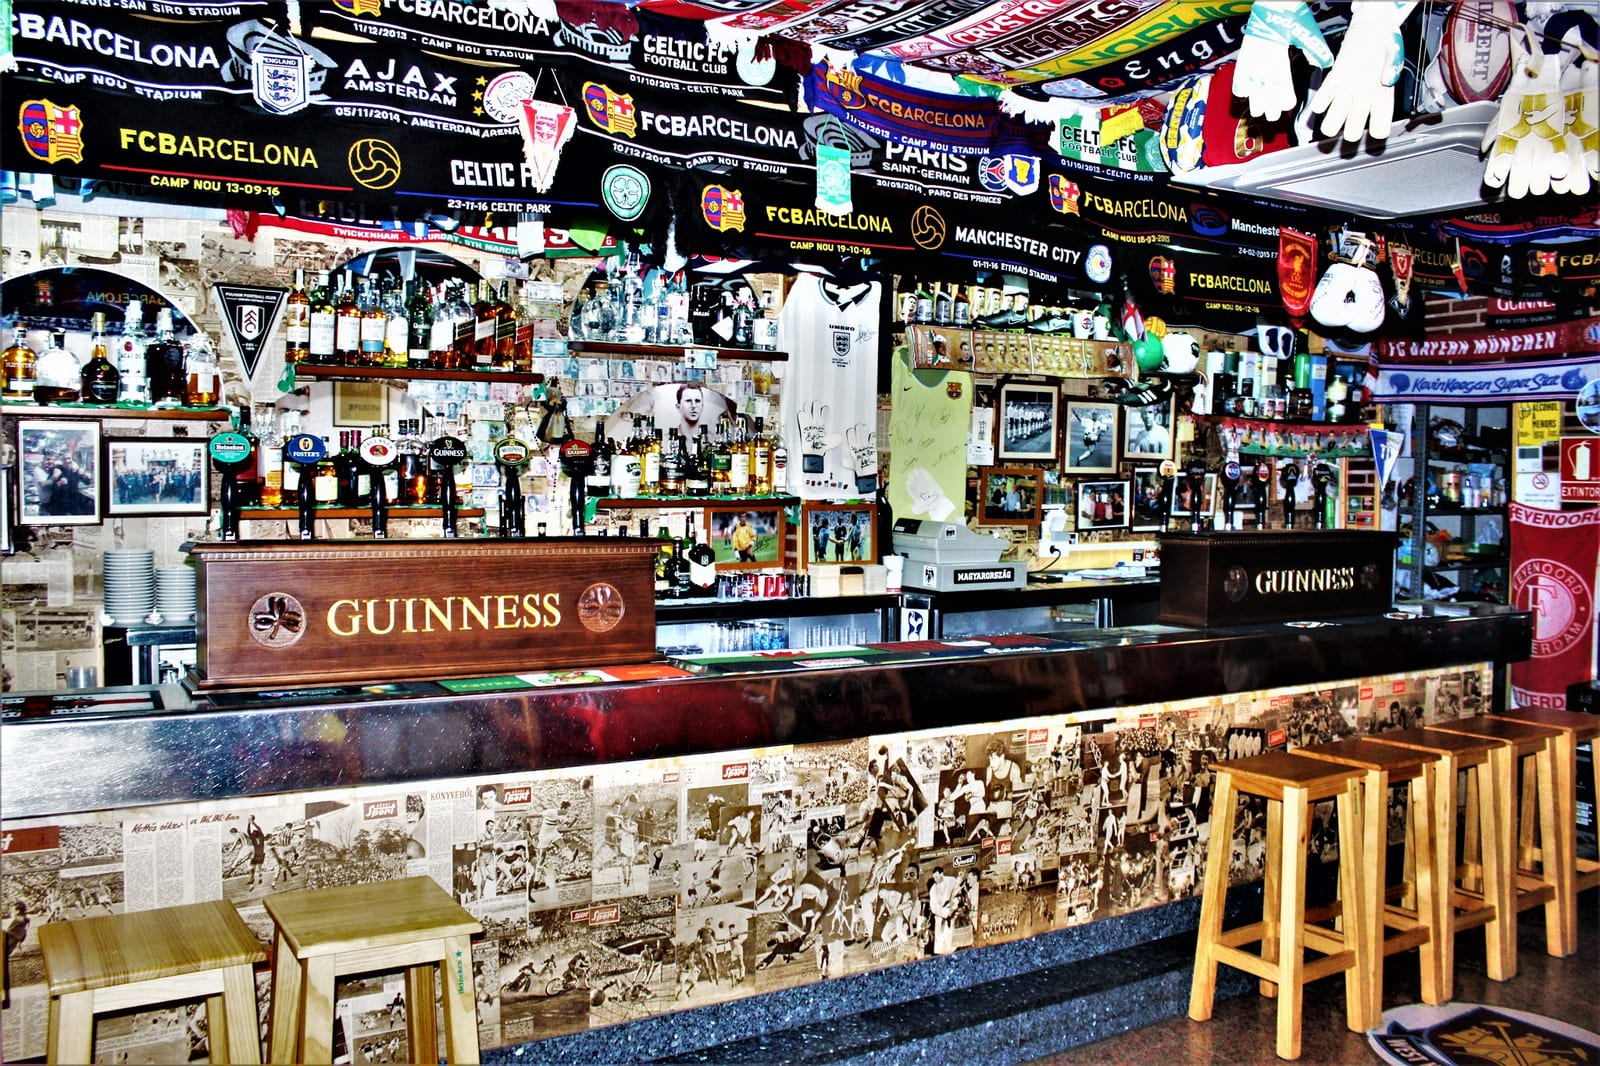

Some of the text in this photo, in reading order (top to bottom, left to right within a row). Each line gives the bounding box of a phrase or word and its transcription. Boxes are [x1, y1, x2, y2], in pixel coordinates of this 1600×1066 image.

[121, 0, 147, 11] SAN
[152, 3, 183, 16] SIRO
[189, 7, 241, 16] STADIUM
[352, 22, 534, 61] 11/12/2013 CAMP NOU STADIUM
[1069, 2, 1252, 66] NORWIC
[643, 34, 729, 64] CELTIC FC
[263, 57, 298, 67] ENGLAND
[643, 53, 728, 75] FOOTBALL CLUB
[42, 66, 202, 101] CAMP NOU STADIUM
[344, 58, 457, 96] AJAX
[629, 74, 745, 98] 01/10/2013 CELTIC PARK
[344, 79, 457, 107] AMSTERDAM
[335, 107, 521, 139] 05/11/2014 AMSTERDAM ARENA
[867, 94, 986, 130] FCBARCELONA
[640, 110, 798, 150] FCBARCELONA
[845, 111, 990, 155] 11/12/2013 CAMP NOU STADIUM
[119, 127, 319, 170] FCBARCELONA
[886, 140, 969, 173] PARIS
[1061, 140, 1138, 163] FOOTBALL CLUB
[1118, 136, 1137, 153] FC
[612, 143, 788, 175] 10/12/2014 CAMP NOU STADIUM
[450, 159, 515, 187] CELTIC
[882, 161, 970, 185] SAINT-GERMAIN
[1106, 168, 1131, 180] CELTIC
[1133, 171, 1154, 182] PARK
[150, 174, 281, 197] CAMP NOU 13-09-16
[928, 189, 952, 199] PARC
[953, 192, 969, 201] DES
[970, 194, 1002, 205] PRINCES
[447, 199, 551, 214] 23-11-16 CELTIC PARK
[1083, 191, 1189, 223] FCBARCELONA
[765, 206, 893, 234] FCBARCELONA
[1231, 218, 1281, 237] Mancheste
[333, 227, 399, 241] TWICKENHAM
[485, 243, 519, 256] MARCH
[789, 240, 872, 256] CAMP NOU 19-10-16
[954, 226, 1082, 265] MANCHESTER CITY
[973, 259, 1058, 284] 01-11-16 ETIHAD STADIUM
[1190, 272, 1272, 294] FCBARCELONA
[1205, 302, 1221, 311] CAMP
[1221, 303, 1235, 311] NOU
[1497, 298, 1557, 312] GUINN
[1388, 330, 1557, 358] FC BAYERN MÜNCHEN
[1490, 376, 1531, 393] Super
[1528, 372, 1562, 391] Star
[292, 450, 320, 458] FOSTER'S
[433, 448, 465, 458] GUINNESS
[1561, 486, 1600, 498] EXTINTOR
[957, 568, 1012, 582] MAGYARORSZÁG
[1255, 567, 1355, 595] GUINNESS
[326, 592, 562, 636] GUINNESS
[1531, 621, 1583, 656] ERDAM
[724, 766, 748, 779] Sport
[504, 789, 531, 805] Sport
[366, 803, 397, 819] Sport
[591, 907, 617, 922] Sport
[1385, 1038, 1428, 1060] WEST
